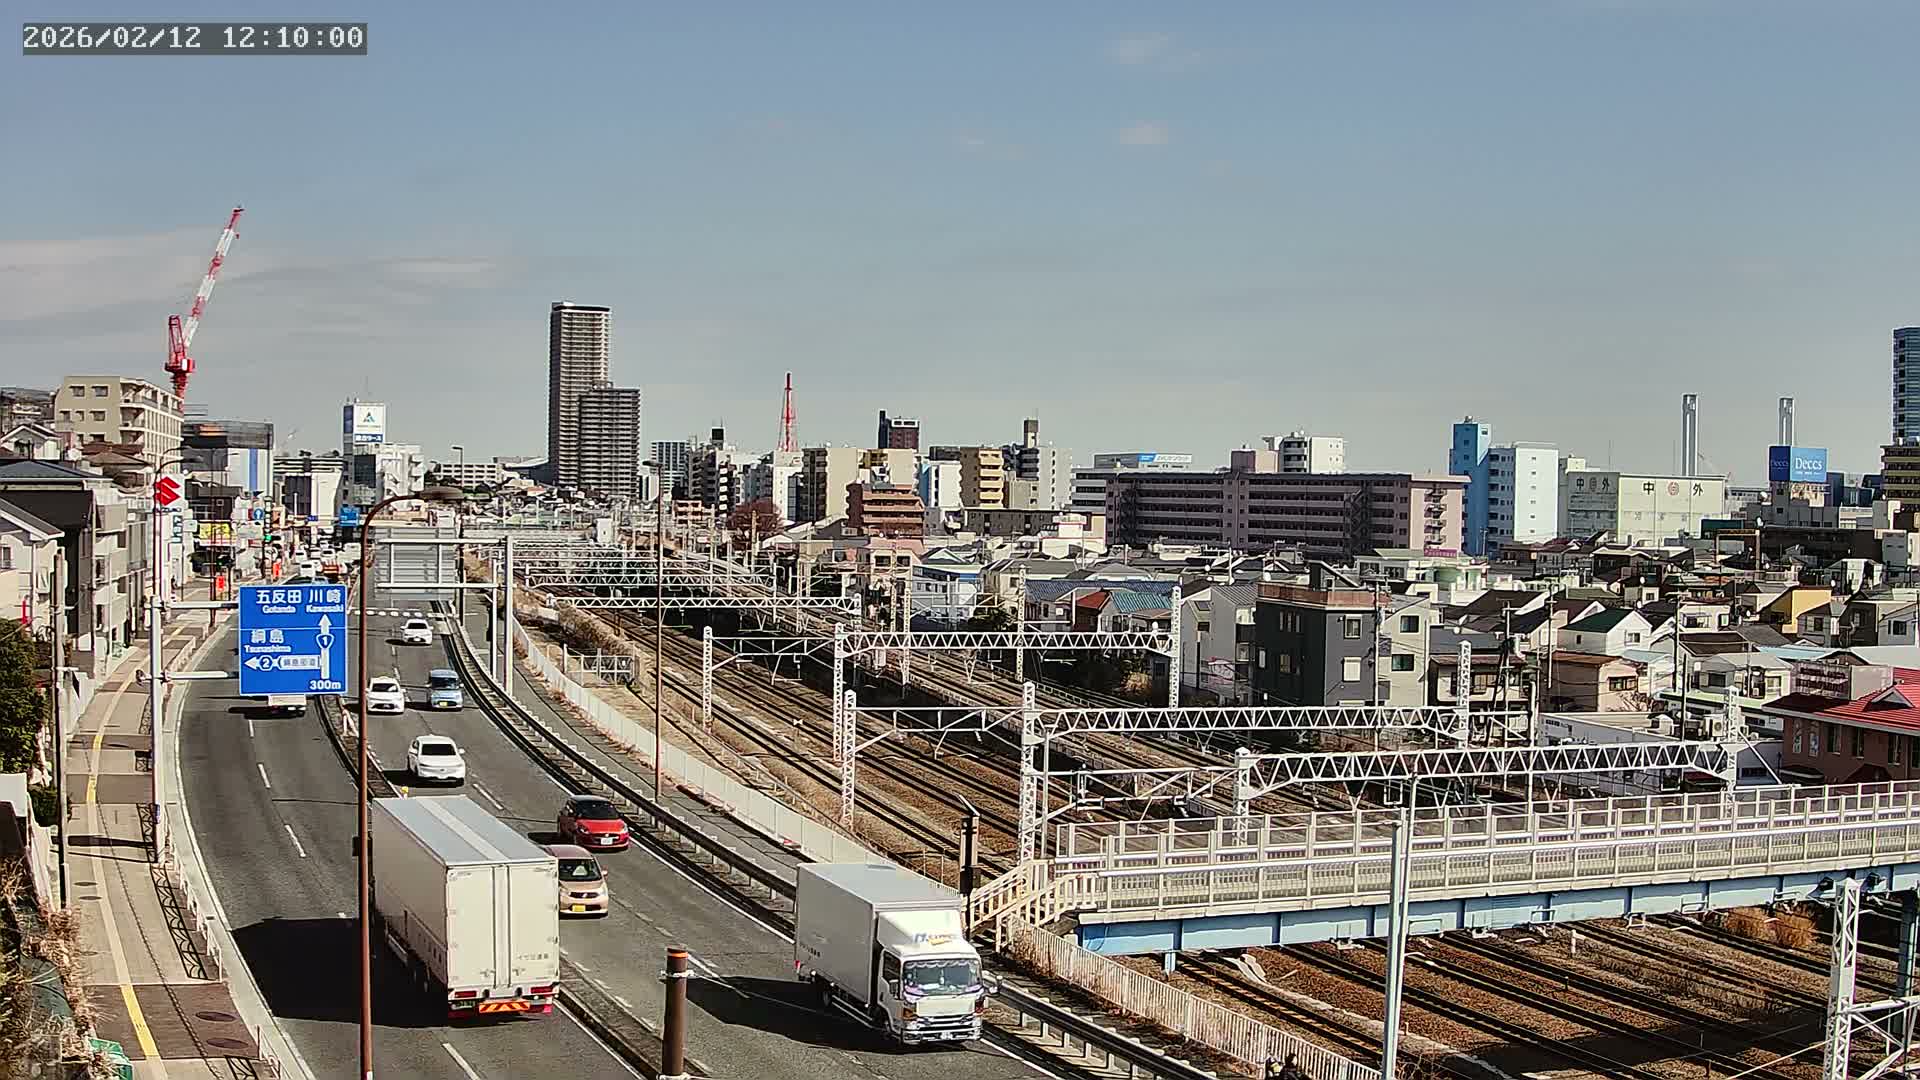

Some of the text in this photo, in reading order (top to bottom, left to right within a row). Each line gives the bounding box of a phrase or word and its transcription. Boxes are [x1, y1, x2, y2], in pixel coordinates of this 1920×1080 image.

[1576, 477, 1585, 490] 中
[1643, 481, 1704, 496] 中 外
[256, 589, 341, 604] 五反田 川崎
[321, 636, 328, 645] 1
[262, 658, 270, 667] 2
[309, 680, 341, 690] 300m
